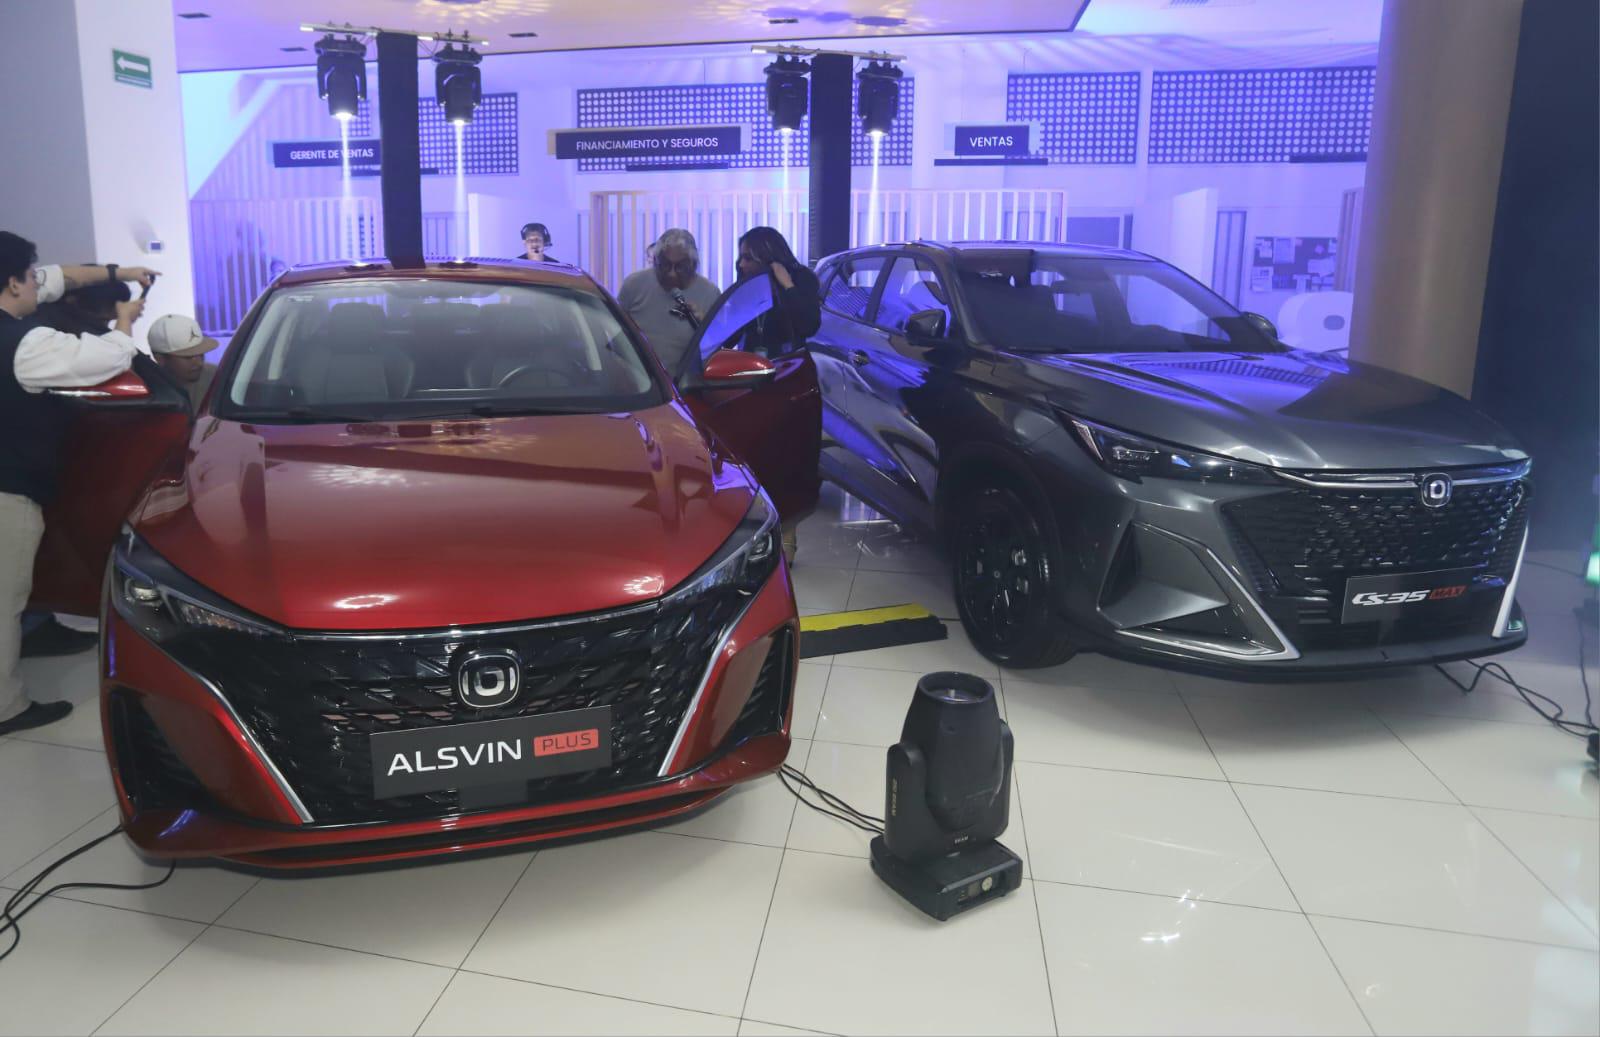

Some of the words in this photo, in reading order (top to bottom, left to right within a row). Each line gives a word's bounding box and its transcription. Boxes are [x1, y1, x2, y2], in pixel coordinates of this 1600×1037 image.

[576, 139, 660, 151] FINANCIAMIENTO
[662, 138, 669, 149] Y
[671, 137, 719, 148] SEGUROS
[969, 136, 1014, 148] VENTAS
[289, 150, 327, 160] GERENTE
[328, 149, 340, 159] DE
[1352, 590, 1431, 605] CS35
[387, 739, 522, 776] ALSVIN
[542, 732, 592, 752] PLUS
